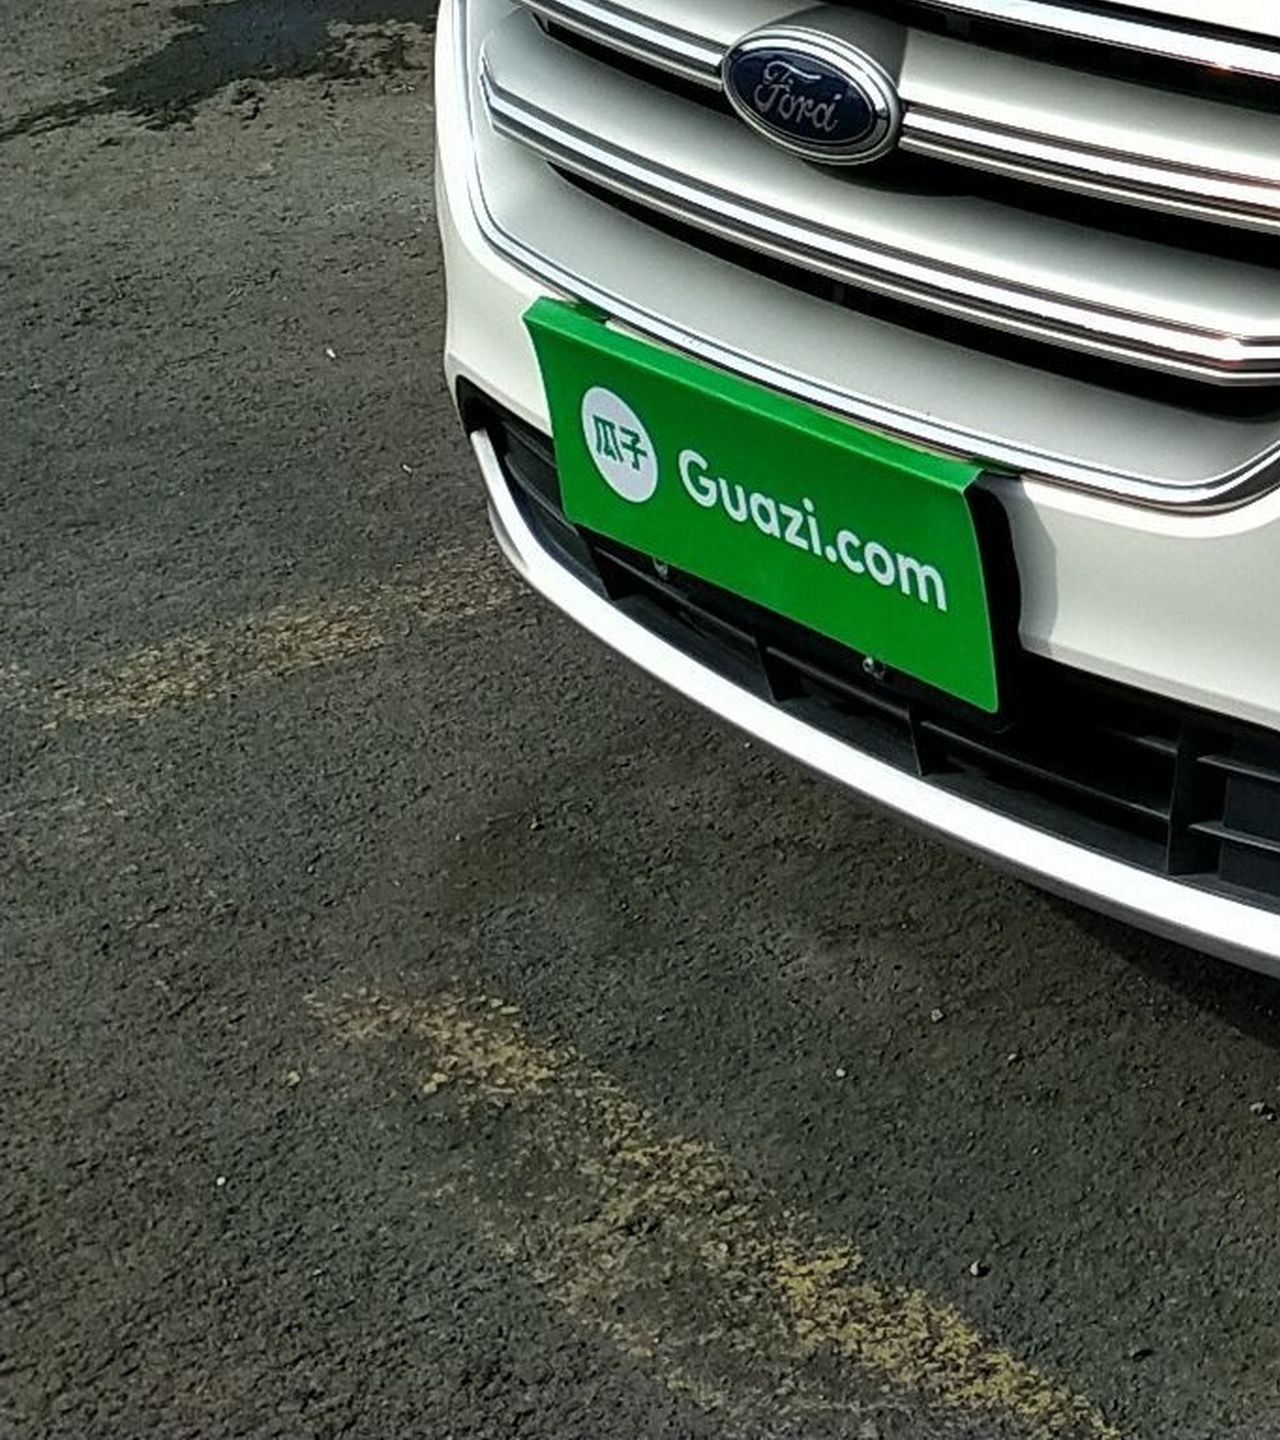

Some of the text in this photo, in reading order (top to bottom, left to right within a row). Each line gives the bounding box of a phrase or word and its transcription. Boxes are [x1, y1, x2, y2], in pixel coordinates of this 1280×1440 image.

[753, 59, 844, 133] Ford
[592, 413, 648, 472] 瓜子
[677, 448, 949, 613] Guazi.com
